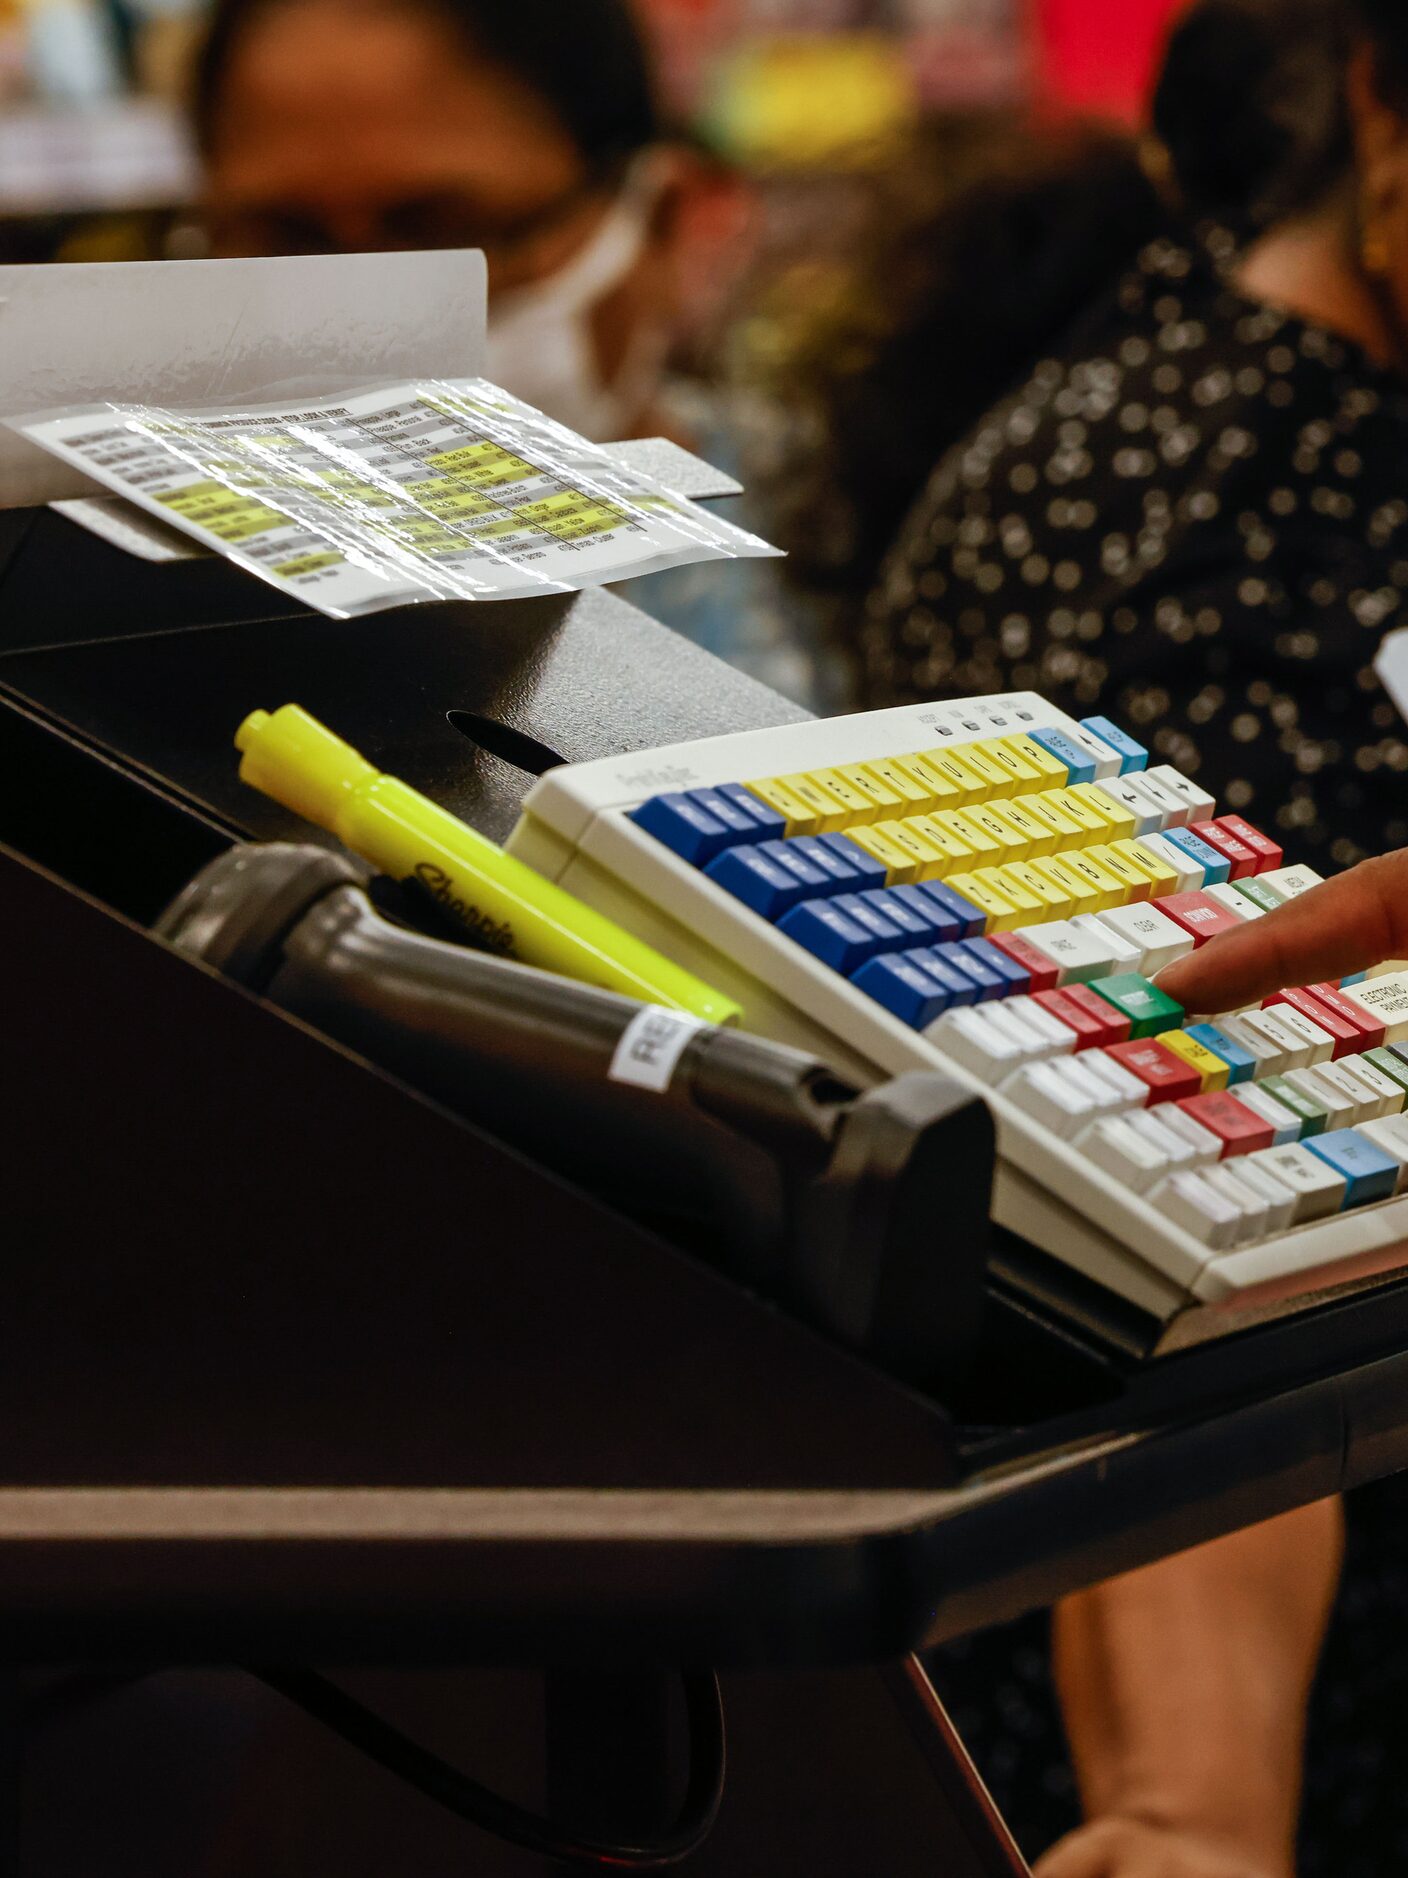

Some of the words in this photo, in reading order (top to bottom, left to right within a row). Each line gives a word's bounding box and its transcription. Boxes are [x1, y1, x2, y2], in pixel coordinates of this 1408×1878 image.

[996, 752, 1018, 768] O
[1023, 746, 1043, 762] P
[912, 767, 934, 784] Y
[941, 761, 963, 778] U
[856, 776, 882, 794] R
[884, 771, 906, 788] T
[827, 781, 850, 798] E
[1060, 800, 1085, 817] K
[980, 816, 1004, 834] G
[1006, 810, 1031, 828] H
[924, 827, 947, 844] D
[952, 821, 974, 838] F
[1104, 856, 1128, 874] N
[1131, 850, 1157, 868] M
[1049, 869, 1072, 885] V
[1076, 863, 1098, 879] B
[994, 879, 1018, 896] X
[1024, 874, 1046, 891] C
[970, 886, 993, 904] Z
[1133, 919, 1160, 932] CLEAR
[1360, 984, 1407, 1004] ELECTRONIC
[1263, 1024, 1284, 1040] 5
[1290, 1017, 1312, 1033] 6
[1336, 1076, 1358, 1092] 2
[1362, 1069, 1382, 1085] 3
